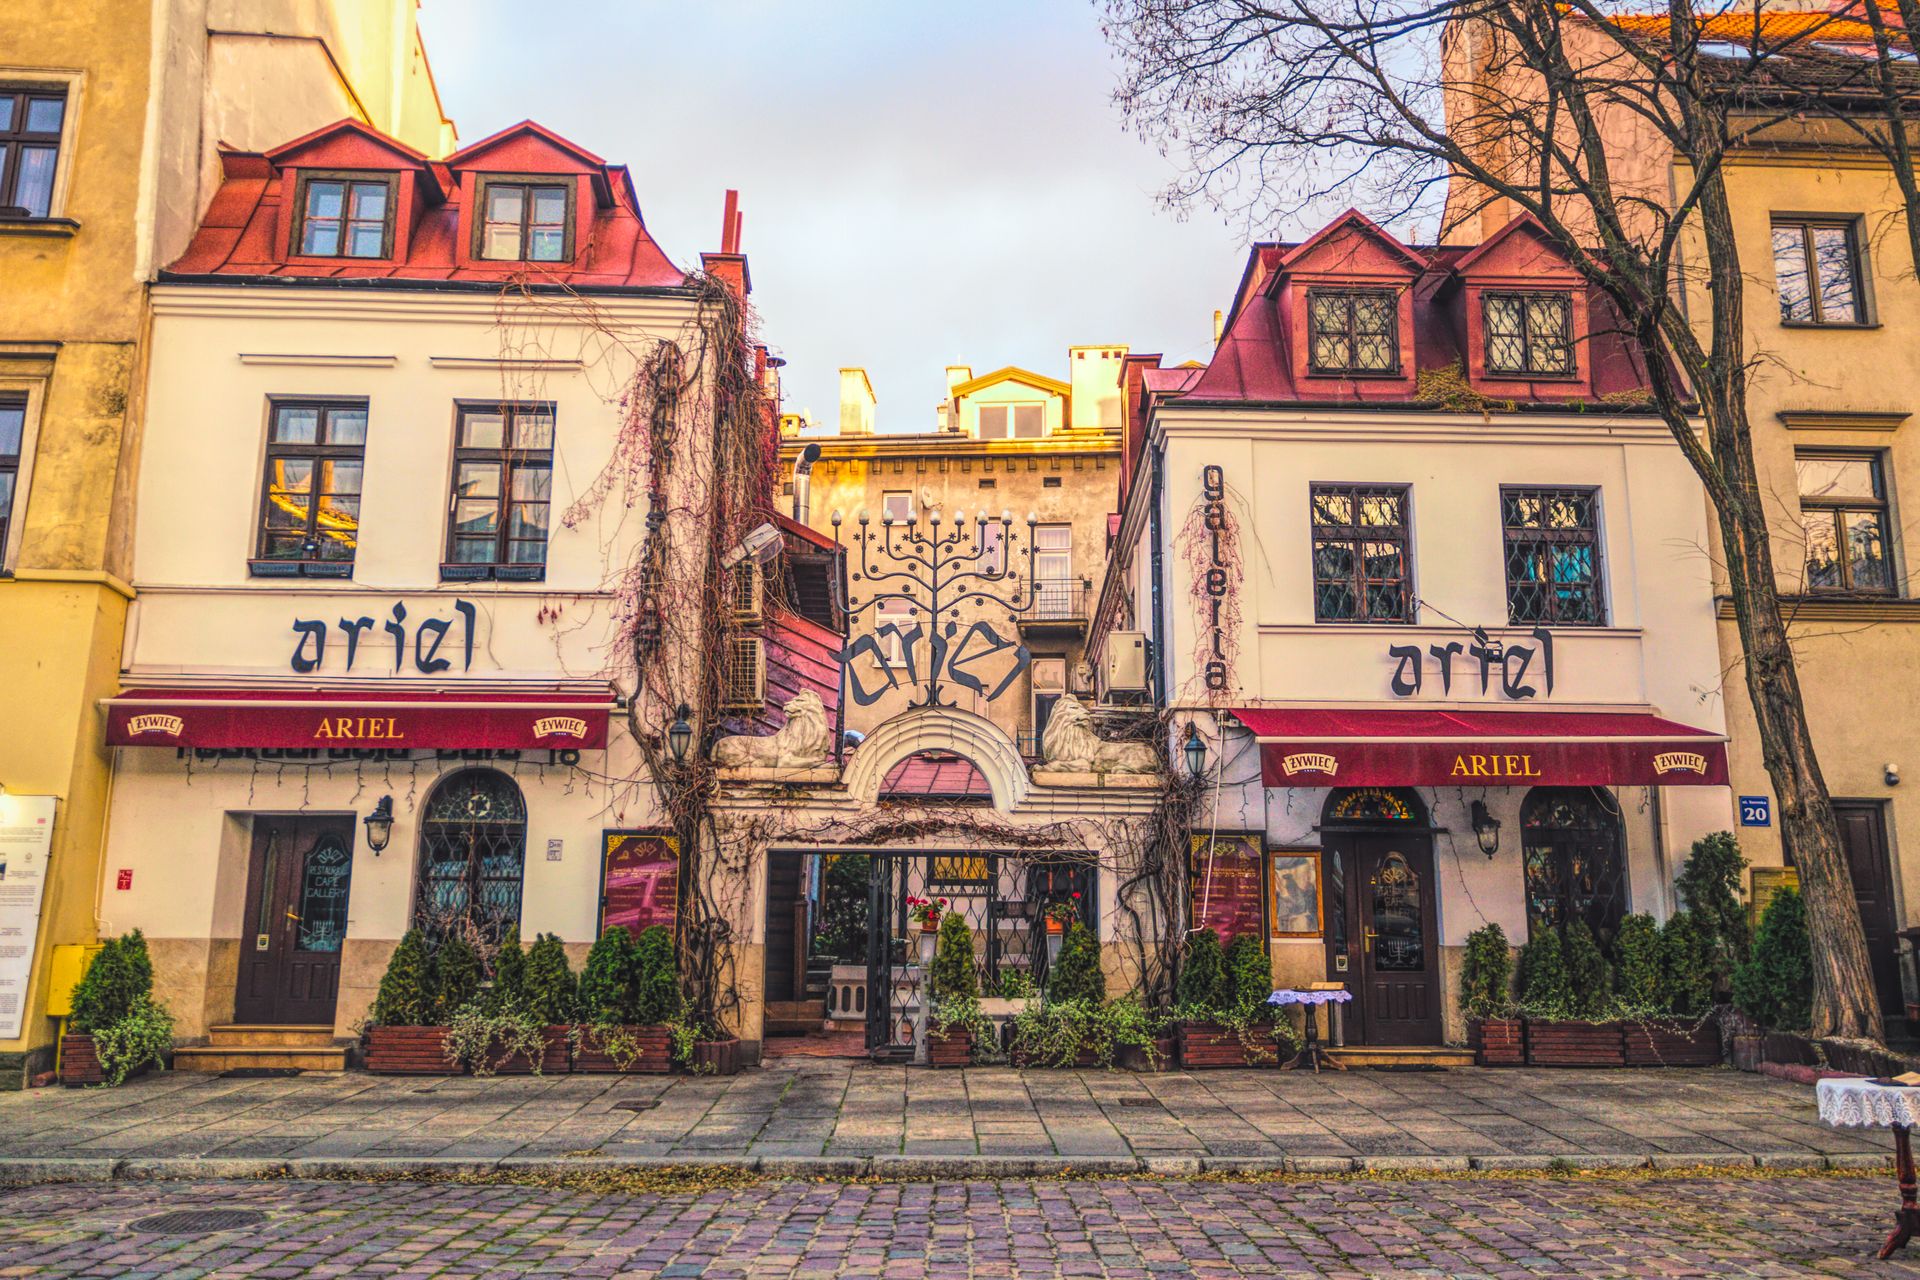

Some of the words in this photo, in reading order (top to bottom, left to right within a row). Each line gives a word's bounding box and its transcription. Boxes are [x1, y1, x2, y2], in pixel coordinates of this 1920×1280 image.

[1203, 464, 1227, 691] galeria
[290, 599, 477, 675] ariel
[1388, 624, 1555, 699] ariel
[135, 715, 178, 730] ŻYWIEC
[313, 717, 405, 738] ARIEL
[540, 718, 582, 732] ŻYWIEC
[1288, 754, 1332, 769] ŻYWIEC
[1450, 754, 1542, 776] ARIEL
[1659, 753, 1701, 768] ŻYWIEC
[1743, 807, 1768, 821] 20
